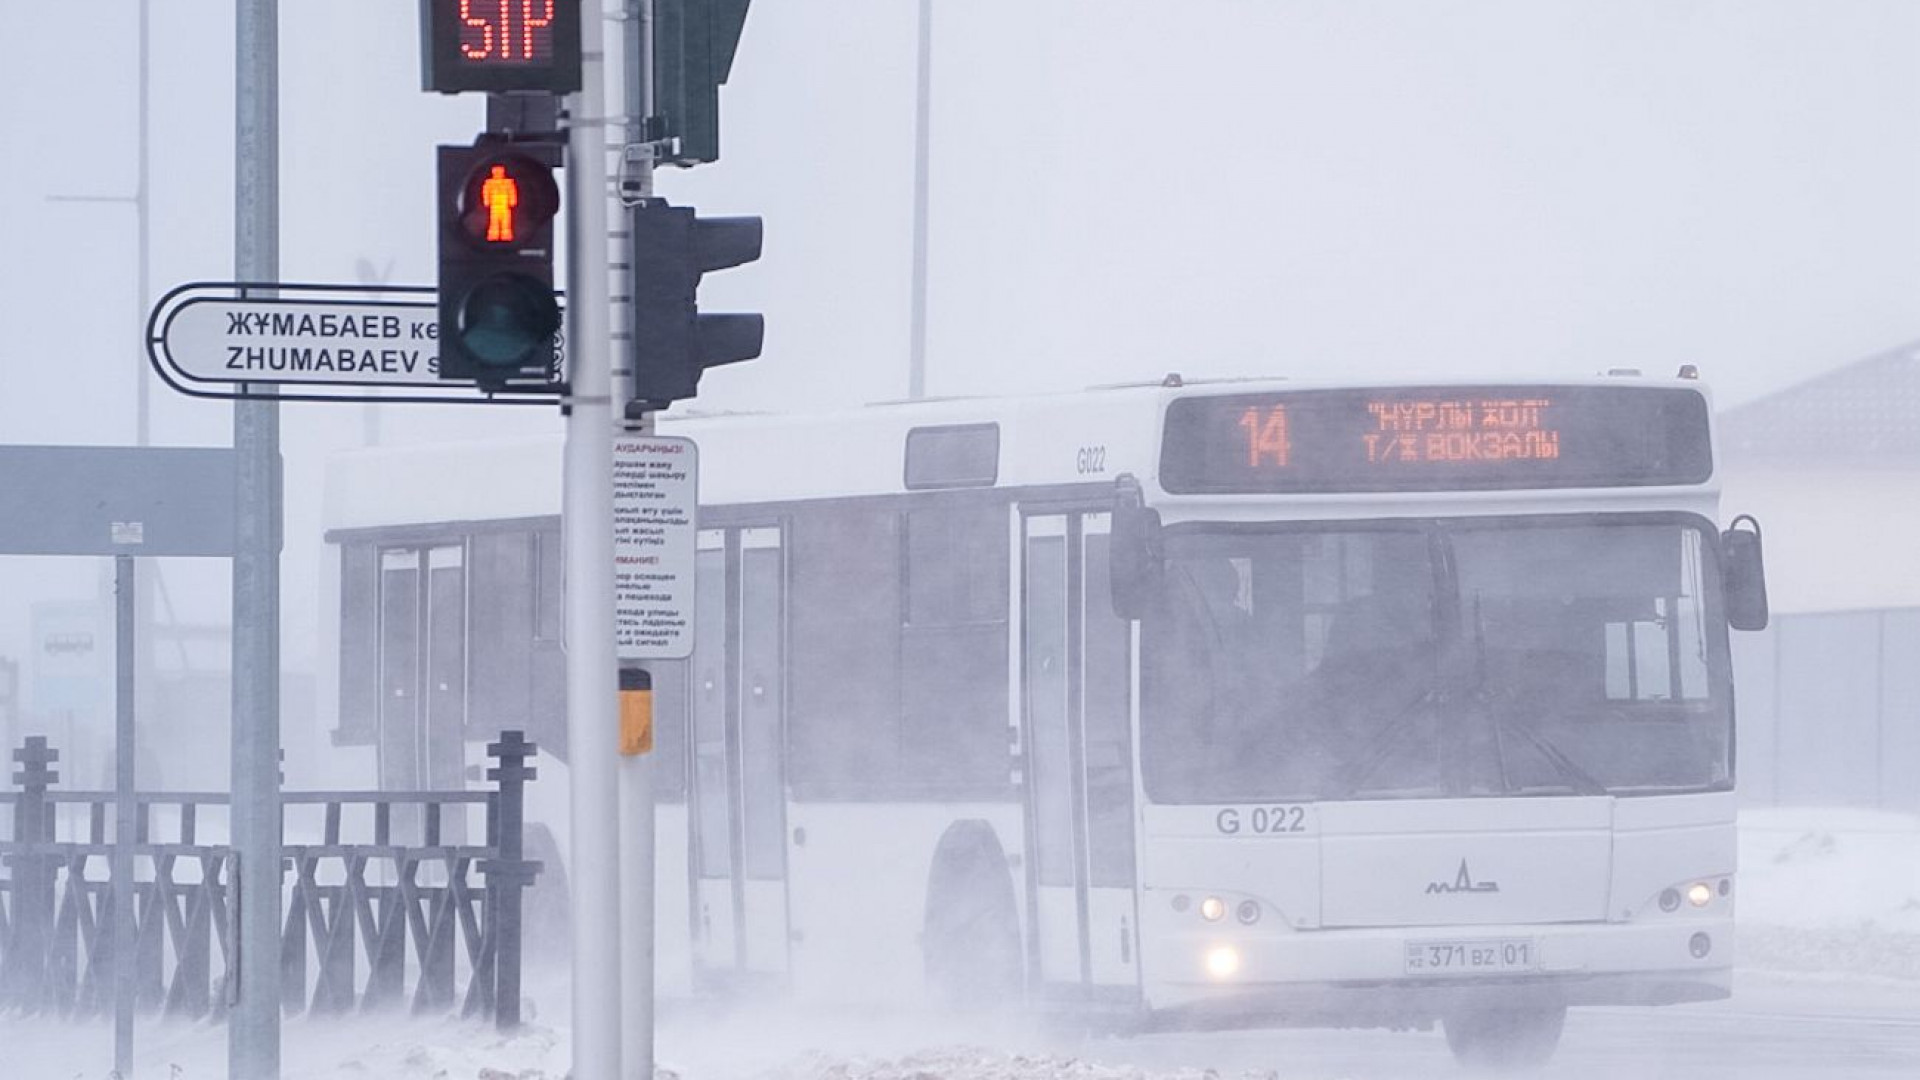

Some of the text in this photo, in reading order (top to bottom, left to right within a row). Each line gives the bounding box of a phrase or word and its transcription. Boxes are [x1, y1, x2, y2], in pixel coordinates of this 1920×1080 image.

[226, 312, 401, 338] ЖҰМАБАЕВ
[226, 346, 419, 373] ZHUMABAEV
[1237, 404, 1292, 467] 14
[1427, 431, 1560, 460] ВОКЗАЛЫ
[1216, 806, 1305, 834] G 022
[1429, 945, 1465, 967] 371
[1504, 943, 1528, 965] 01
